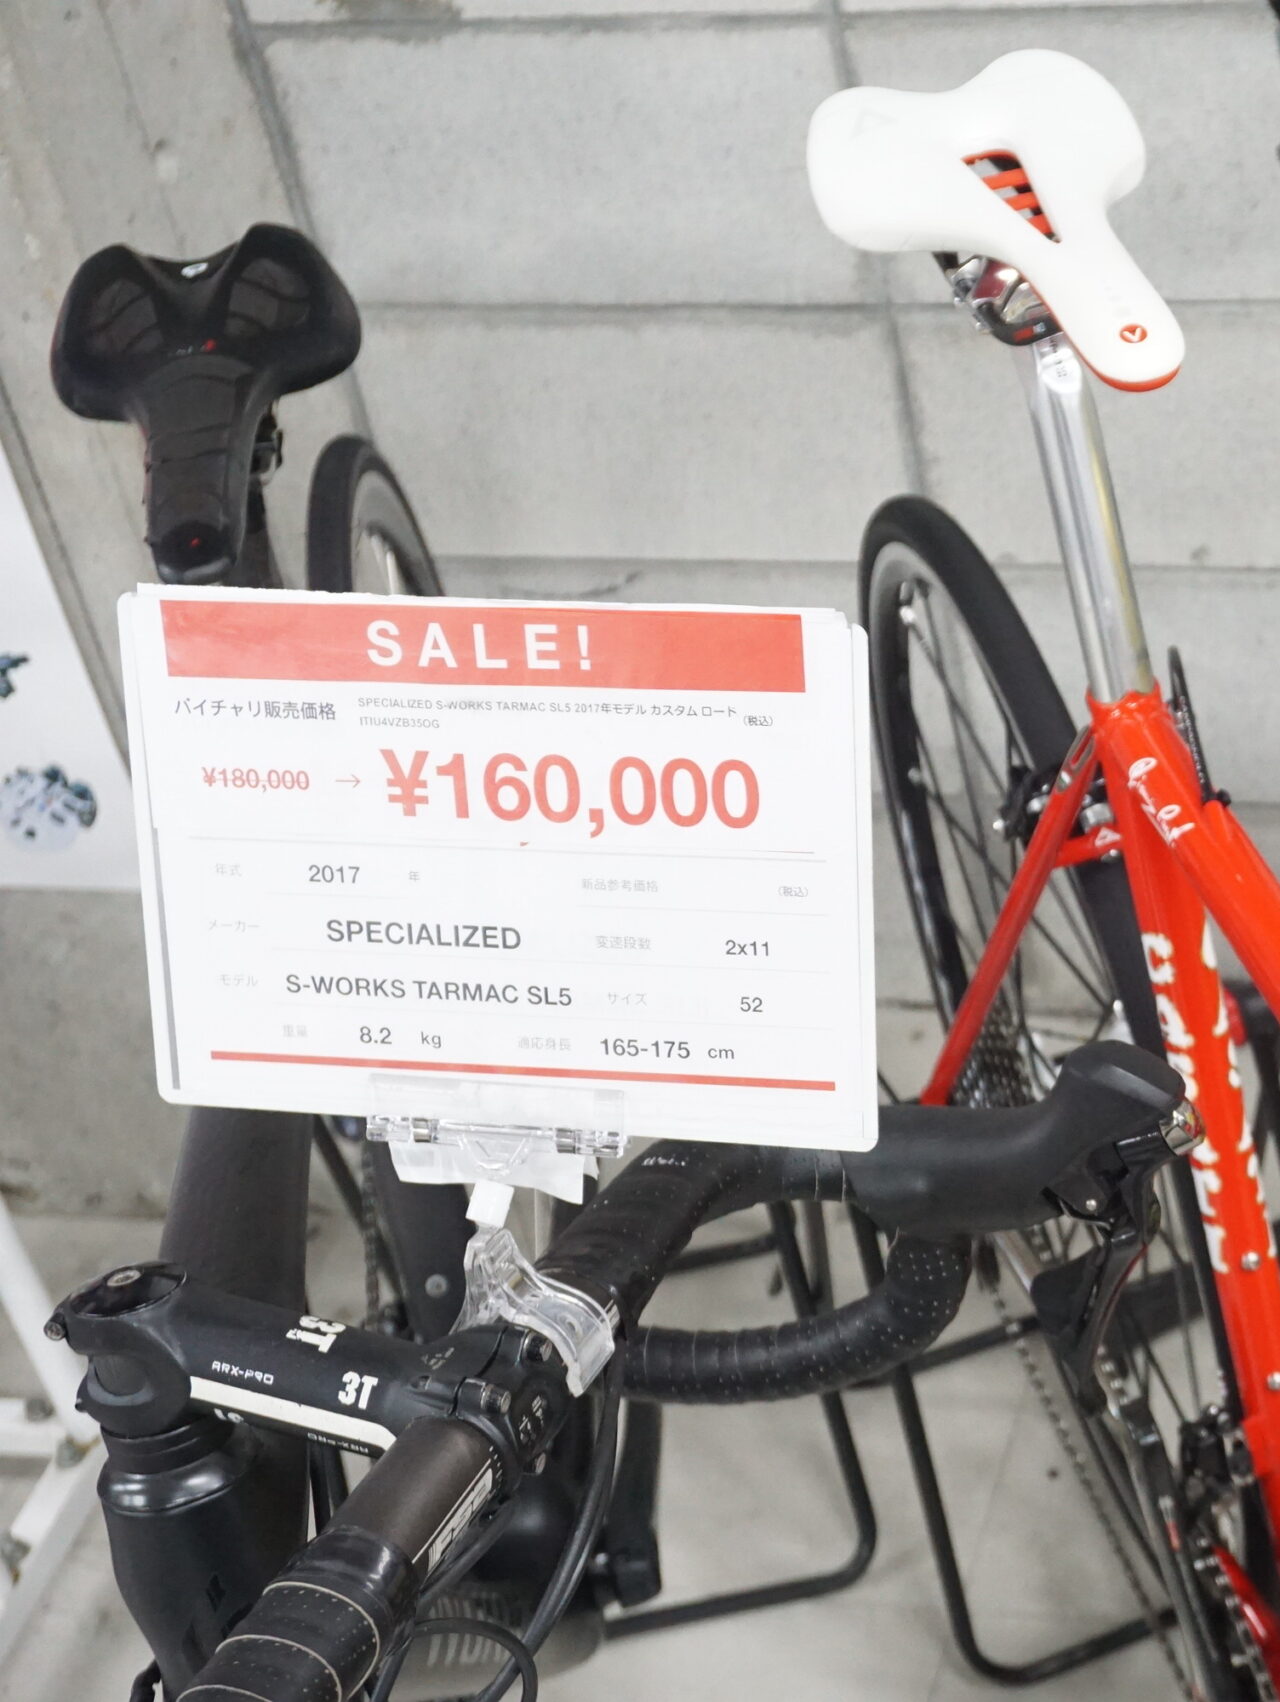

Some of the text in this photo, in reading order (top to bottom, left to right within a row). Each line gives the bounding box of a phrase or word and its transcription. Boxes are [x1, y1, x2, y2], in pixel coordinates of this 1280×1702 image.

[366, 619, 594, 673] SALE!
[174, 697, 337, 721] バイチャリ販売価格
[357, 697, 737, 717] SPECIALIZED S-WORKS TARMAC SL5 2017年モデル カスタム ロード
[201, 766, 310, 792] ¥180,000
[379, 748, 761, 838] ¥160,000
[307, 864, 360, 884] 2017
[326, 919, 522, 950] SPECIALIZED
[725, 939, 771, 957] 2x11
[285, 974, 407, 999] S-WORKS
[412, 980, 519, 1005] TARMAC
[527, 985, 573, 1007] SL5
[739, 996, 764, 1013] 52
[359, 1026, 393, 1045] 8.2
[420, 1031, 442, 1050] kg
[600, 1038, 691, 1059] 165-175
[708, 1047, 735, 1060] cm
[211, 1360, 274, 1385] ARX-PRO
[338, 1370, 379, 1410] 3T
